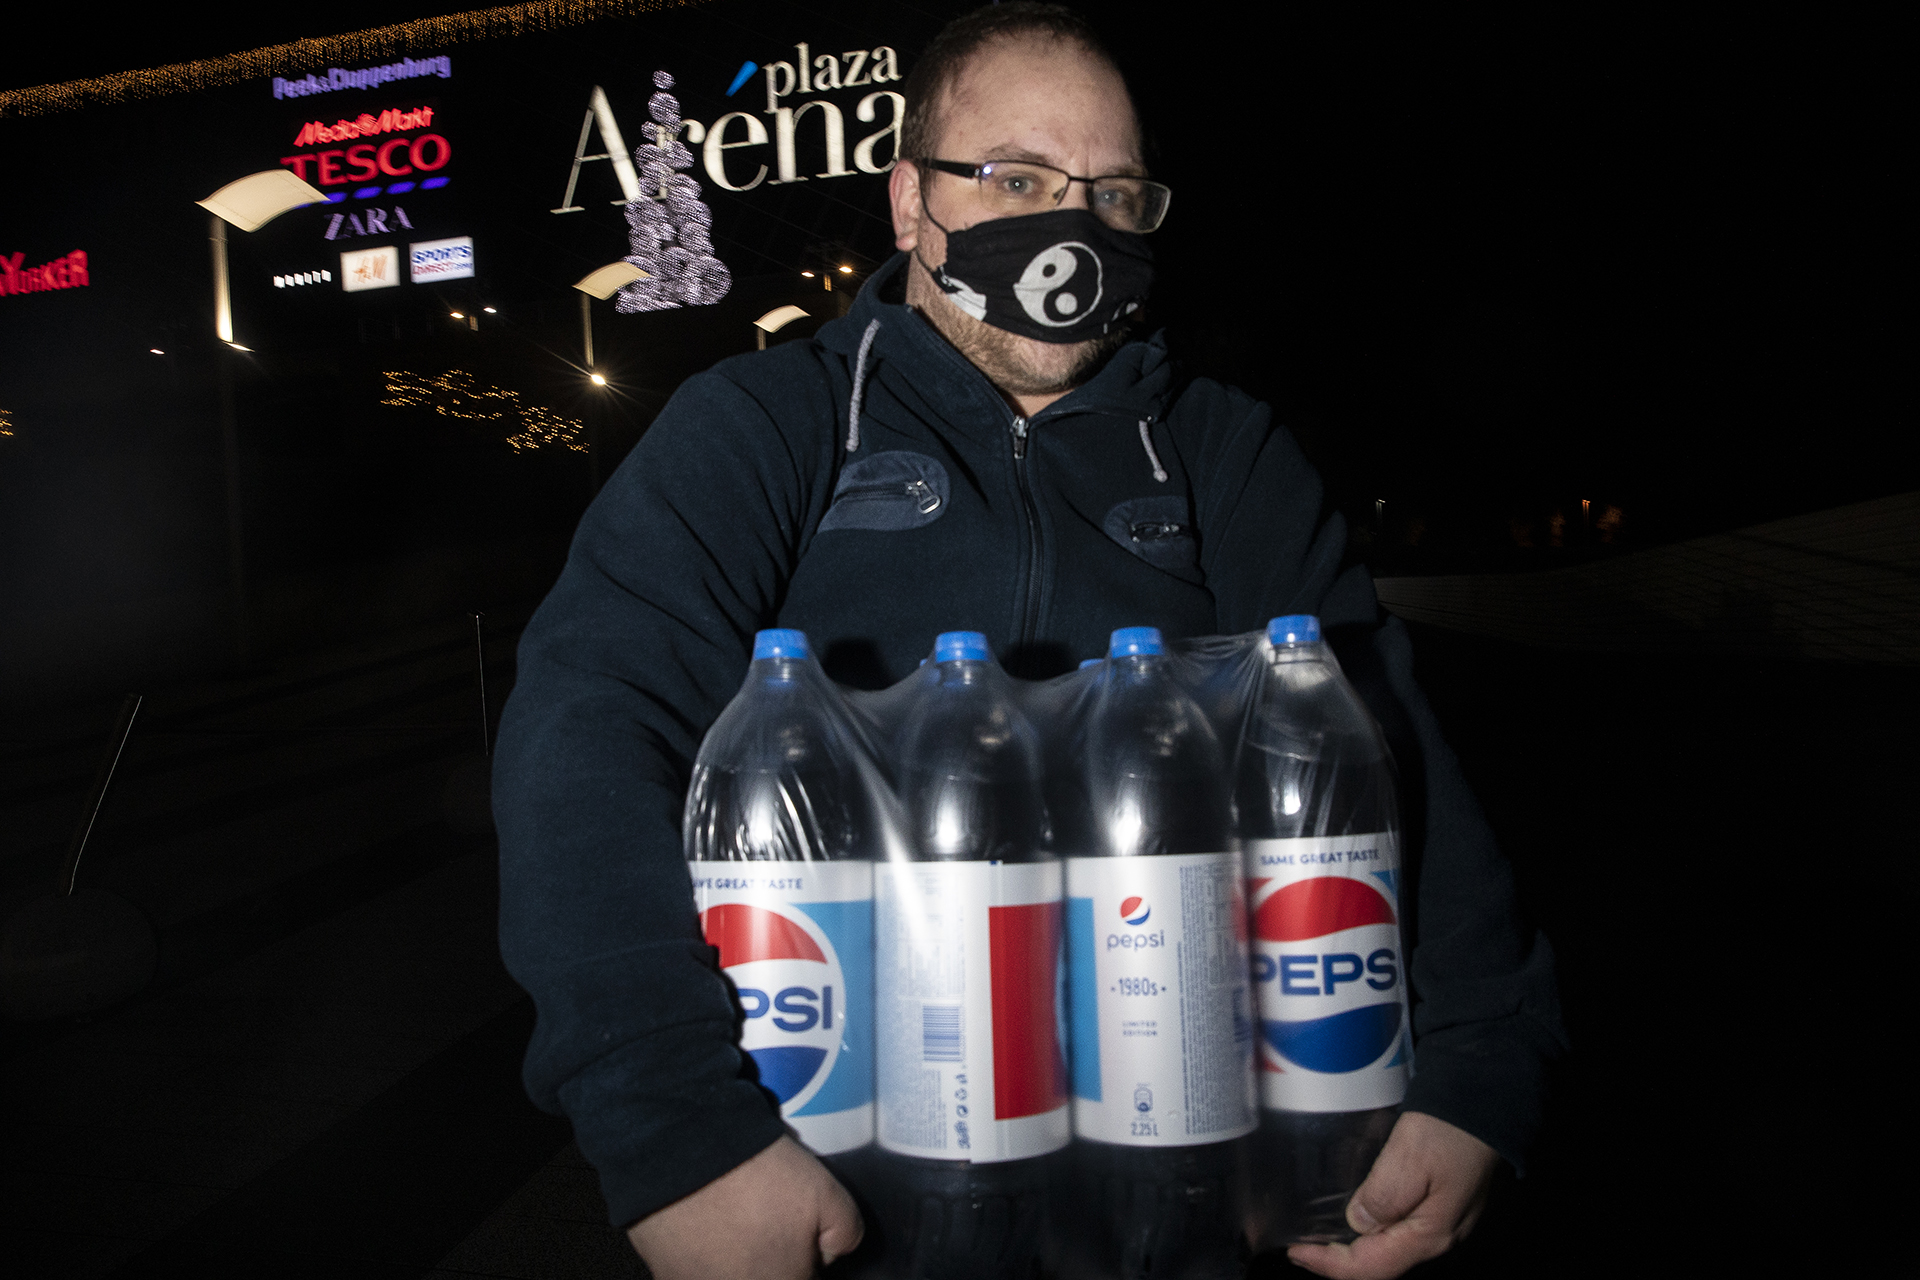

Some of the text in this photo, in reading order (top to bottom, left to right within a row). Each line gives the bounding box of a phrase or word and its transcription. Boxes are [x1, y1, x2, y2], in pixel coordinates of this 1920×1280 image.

[762, 41, 903, 114] plaza
[280, 133, 452, 187] TESCO
[323, 205, 414, 241] ZARA
[1261, 854, 1295, 866] SAME
[1299, 852, 1343, 864] GREAT
[1106, 929, 1165, 952] pepsi
[1118, 977, 1158, 996] 1980s
